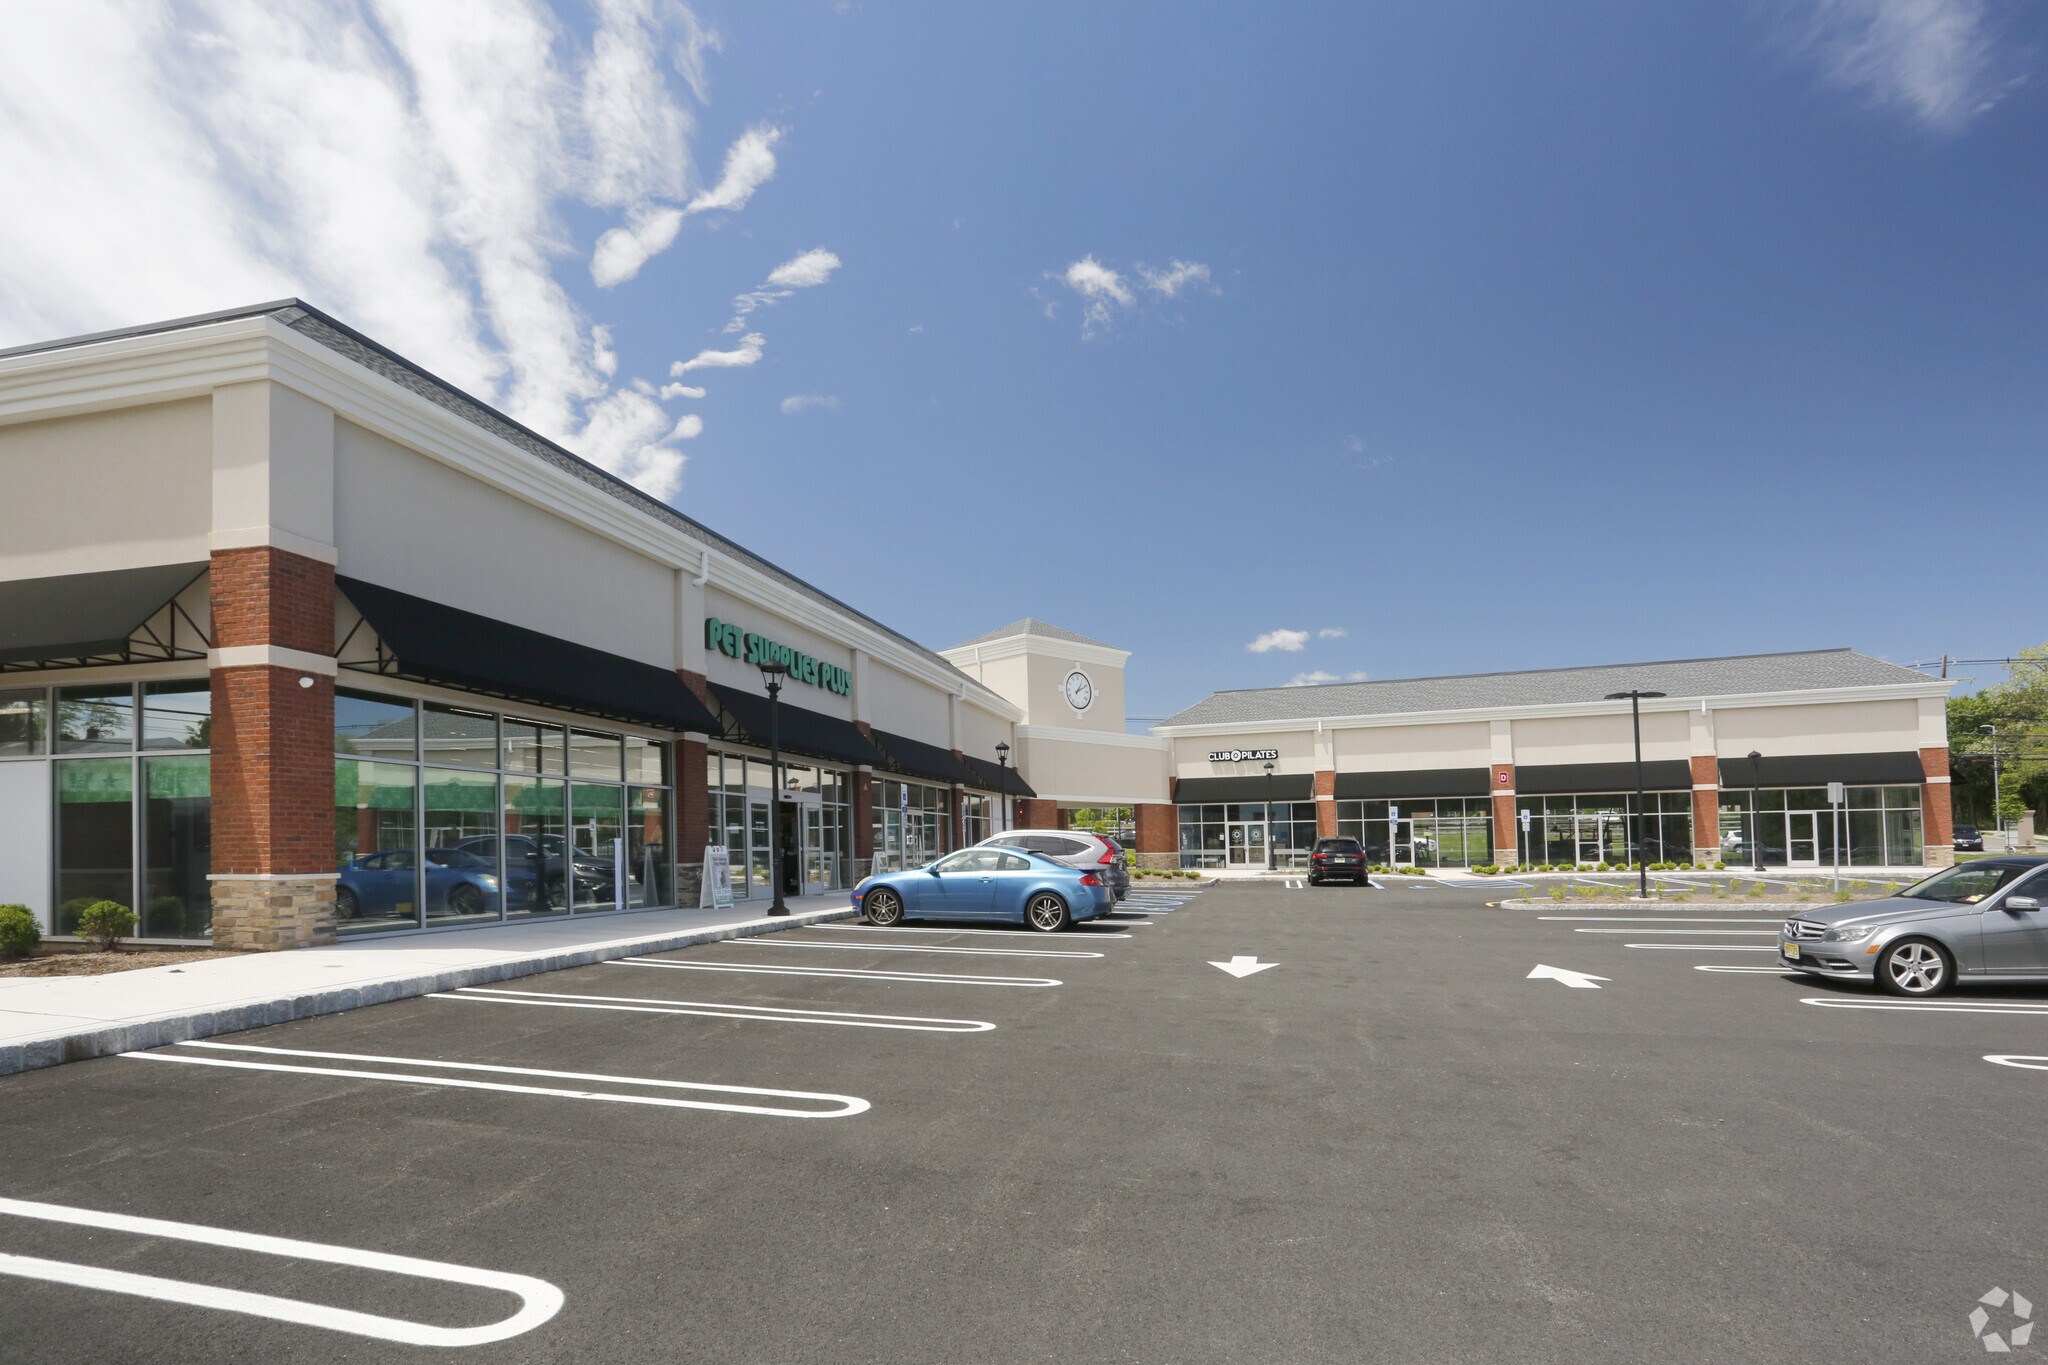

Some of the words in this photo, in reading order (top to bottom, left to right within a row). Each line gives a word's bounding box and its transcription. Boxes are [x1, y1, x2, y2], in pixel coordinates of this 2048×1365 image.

[705, 617, 743, 659] PET
[744, 633, 819, 685] SUPPLIES
[818, 662, 853, 697] PLUS
[1208, 752, 1231, 761] CLUB
[1241, 750, 1277, 760] PILATES
